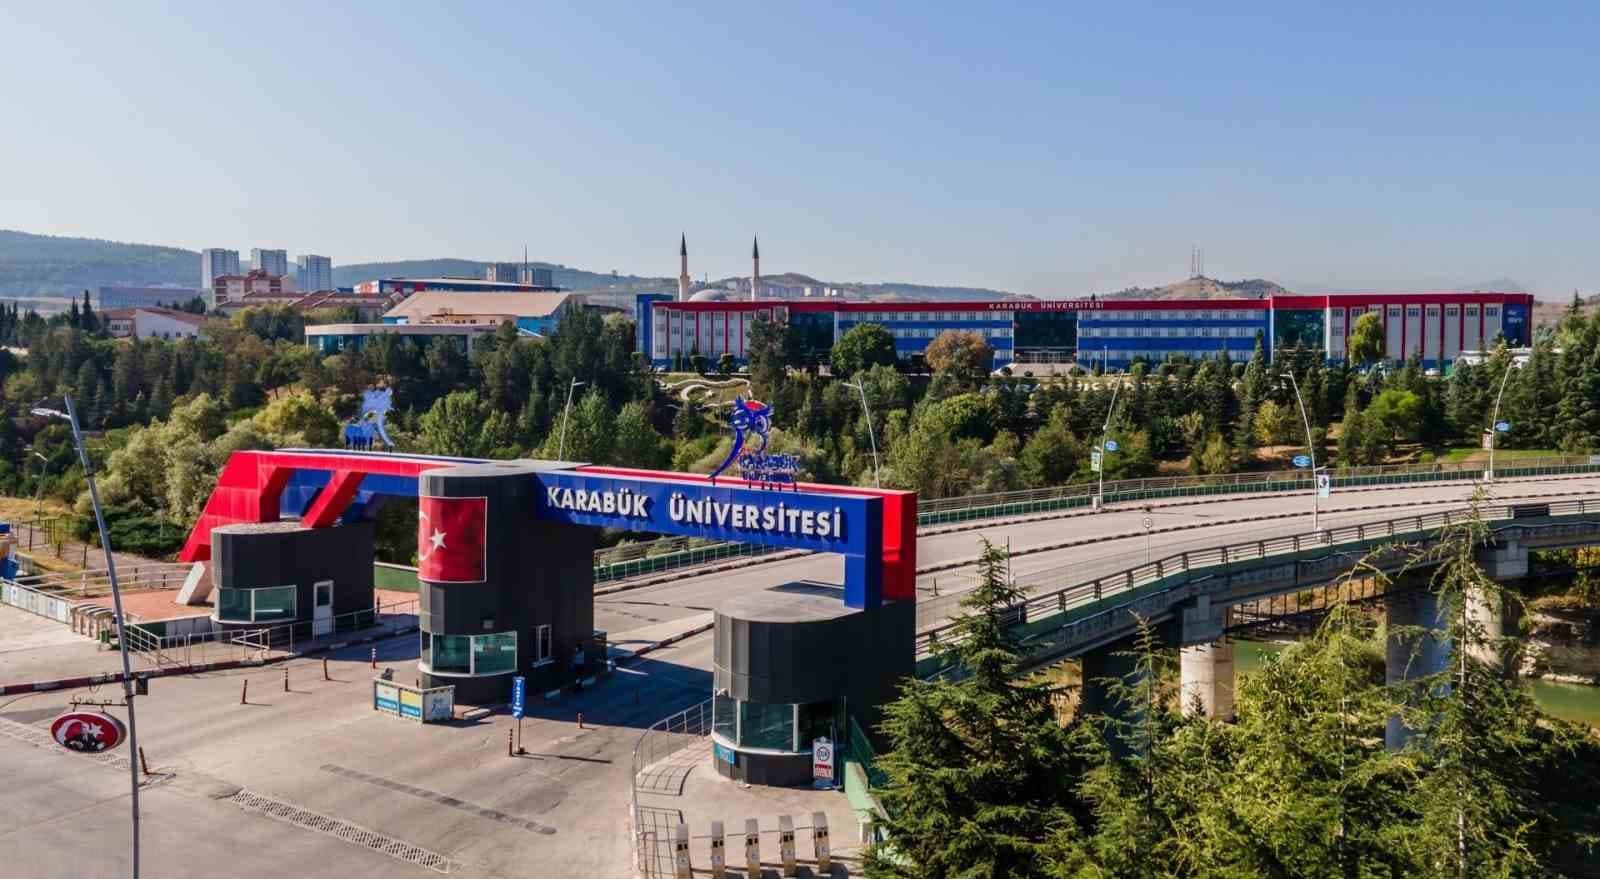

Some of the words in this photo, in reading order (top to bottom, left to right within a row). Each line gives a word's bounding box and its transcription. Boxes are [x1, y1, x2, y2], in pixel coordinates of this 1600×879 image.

[988, 302, 1033, 310] KARABÜK
[547, 486, 649, 517] KARABÜK
[669, 492, 841, 538] ÜNİVERSİTESİ
